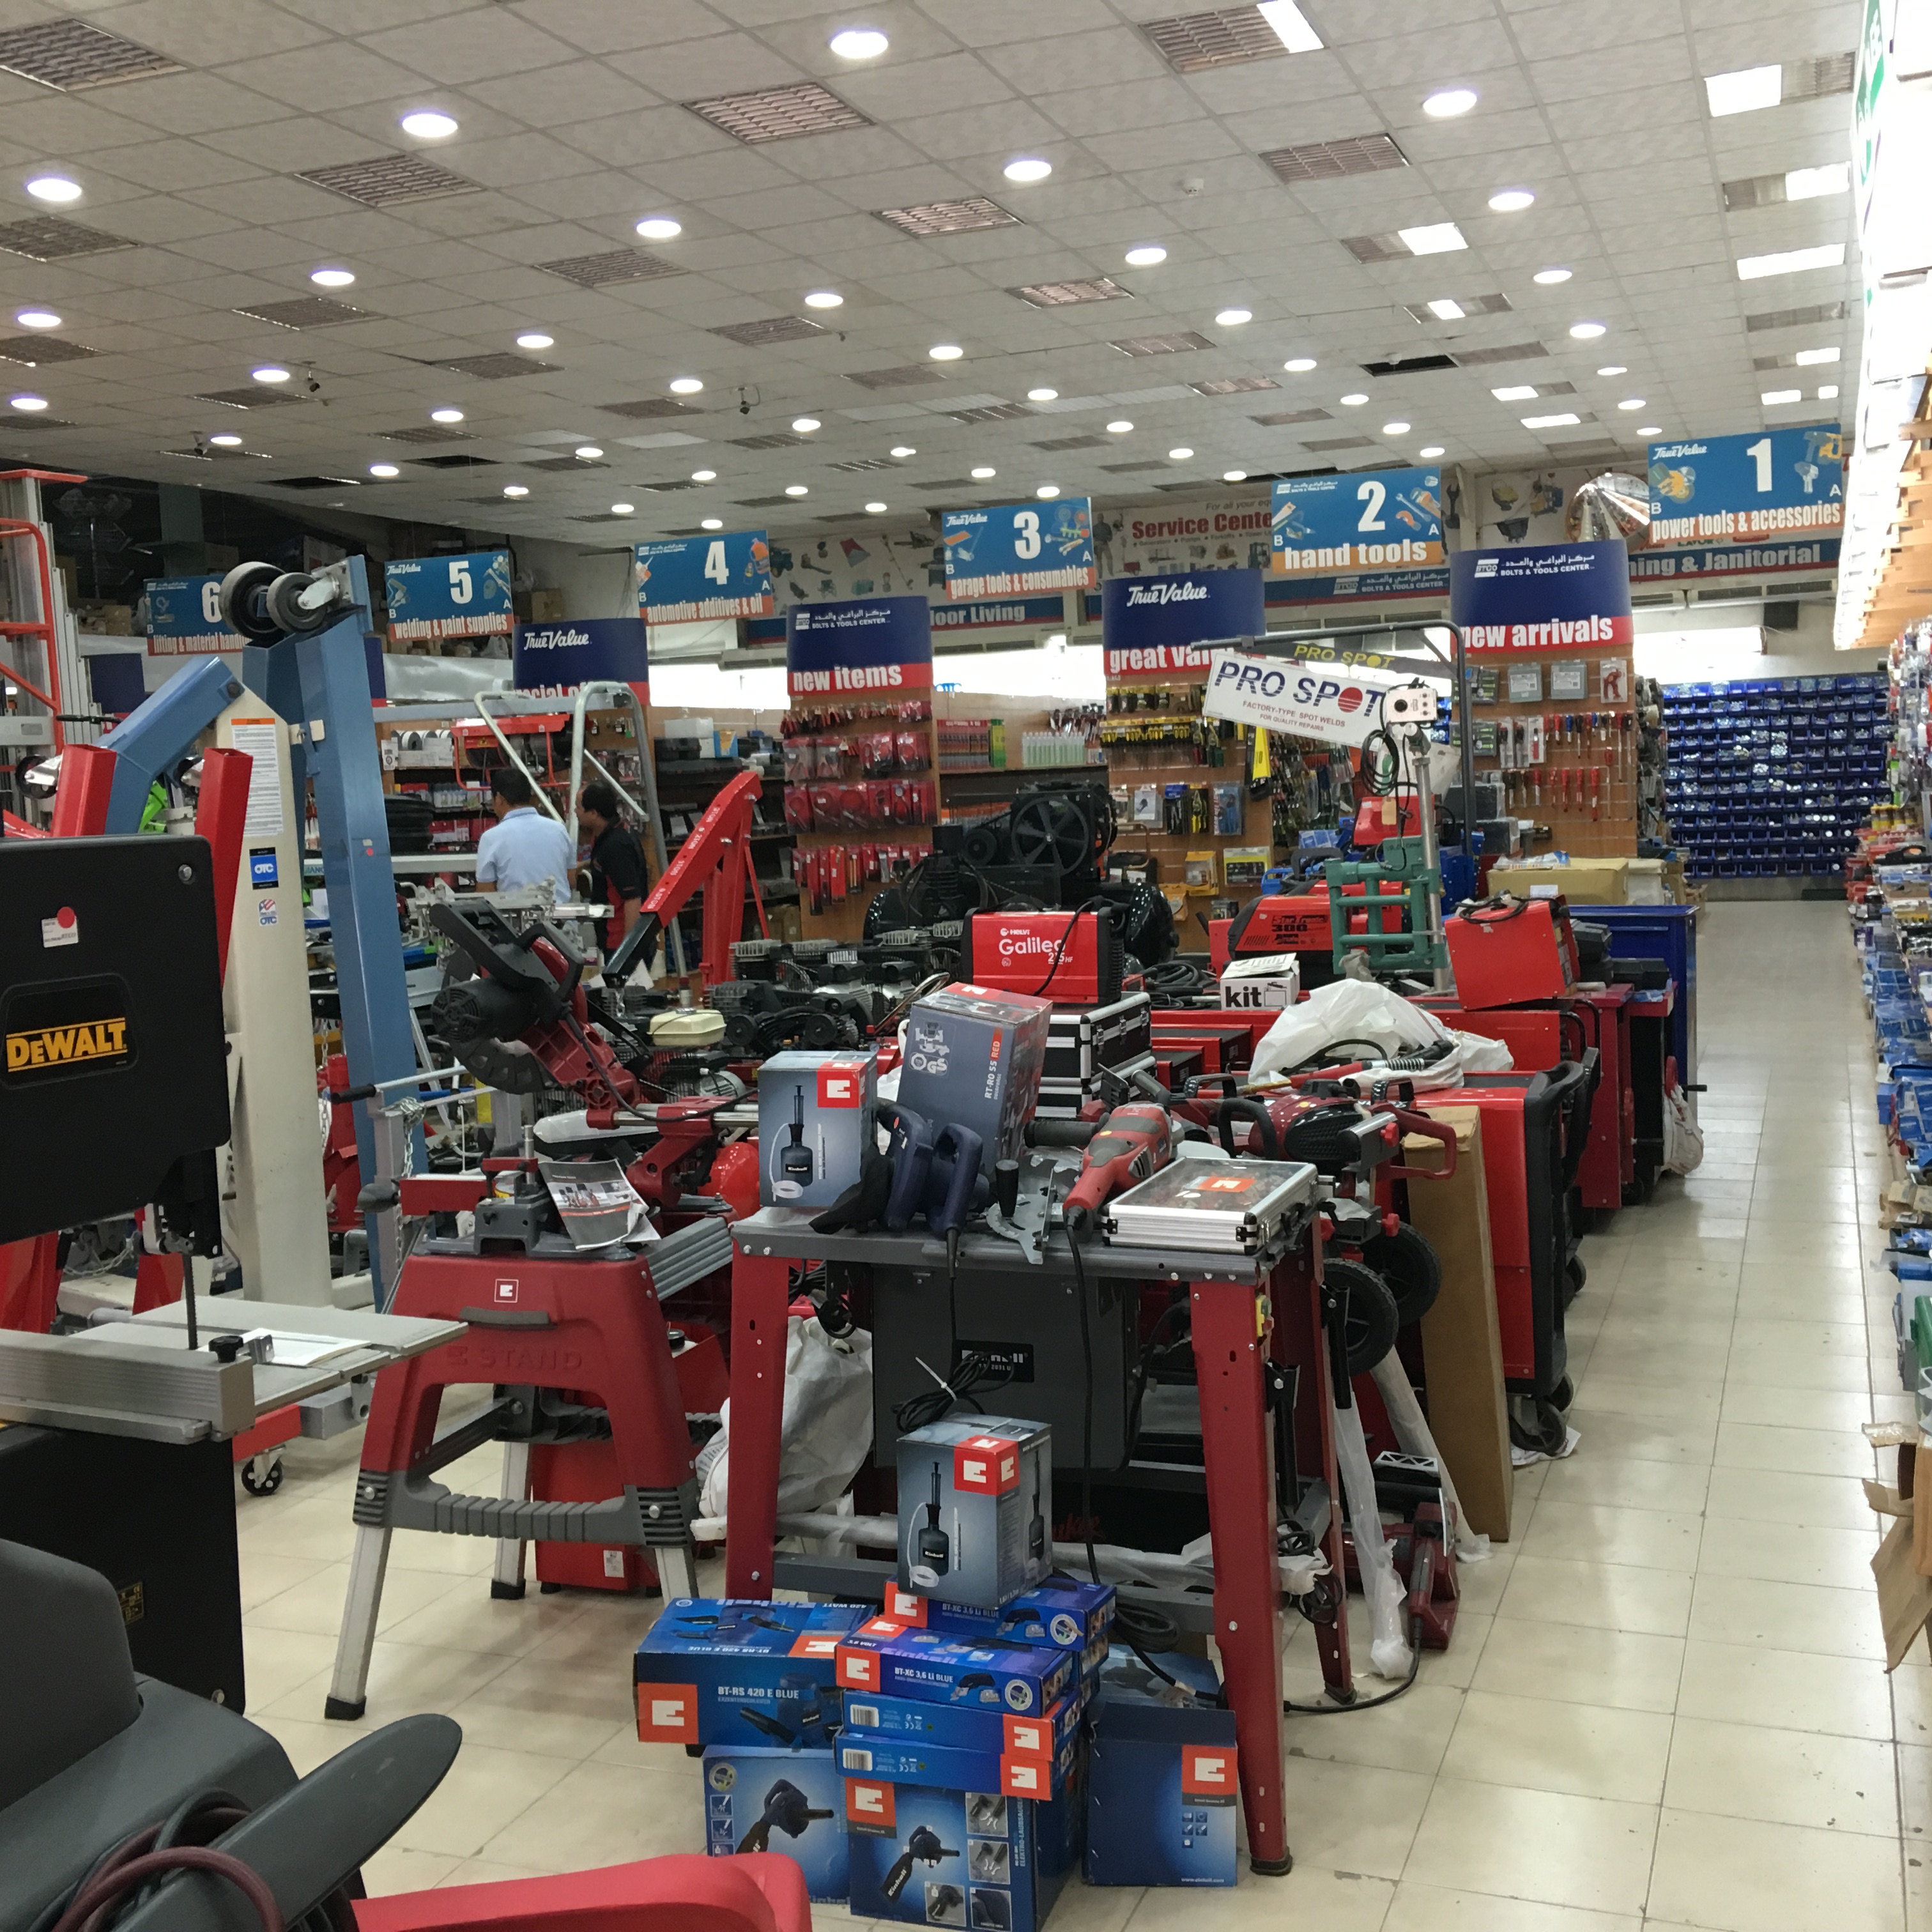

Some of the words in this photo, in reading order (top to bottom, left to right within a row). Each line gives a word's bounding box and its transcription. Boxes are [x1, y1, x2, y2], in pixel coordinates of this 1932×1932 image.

[1747, 438, 1772, 493] 1
[1829, 484, 1842, 497] A
[1206, 502, 1221, 511] For
[1223, 502, 1234, 510] all
[1236, 501, 1255, 513] your
[1357, 480, 1386, 532] 2
[1651, 502, 1662, 514] B
[1132, 518, 1209, 539] Service
[1429, 523, 1439, 536] A
[1652, 516, 1696, 542] power
[1699, 510, 1735, 537] tools
[1738, 512, 1748, 532] &
[1751, 500, 1841, 530] accessories
[1013, 511, 1041, 560] 3
[1274, 535, 1284, 546] B
[705, 540, 729, 585] 4
[1082, 551, 1092, 562] A
[1285, 542, 1351, 569] hand
[1357, 539, 1427, 564] tools
[1535, 554, 1566, 567] البراغي
[1568, 555, 1595, 564] مركز
[1681, 556, 1699, 572] &
[1703, 544, 1820, 571] Janitorial
[946, 564, 954, 574] B
[1560, 564, 1590, 572] CENTER
[449, 560, 473, 604] 5
[762, 580, 770, 590] A
[951, 576, 985, 600] garage
[986, 571, 1011, 594] tools
[1013, 573, 1021, 592] &
[1022, 565, 1089, 591] consumables
[201, 581, 222, 623] 6
[503, 599, 511, 609] A
[639, 592, 647, 602] B
[389, 609, 396, 618] B
[647, 600, 697, 624] automotive
[698, 595, 740, 618] additives
[742, 597, 749, 615] &
[750, 593, 763, 613] oil
[970, 605, 1025, 624] Living
[147, 624, 154, 634] B
[394, 618, 432, 640] welding
[433, 619, 440, 636] &
[441, 615, 466, 638] paint
[466, 611, 508, 634] supplies
[859, 617, 886, 625] CENTER
[1460, 624, 1506, 648] new
[1512, 615, 1613, 647] arrivals
[153, 634, 178, 656] lifting
[178, 636, 185, 652] &
[185, 632, 219, 652] material
[1110, 645, 1168, 673] great
[1294, 644, 1335, 662] PRO
[1340, 650, 1395, 669] SPOT
[793, 670, 830, 692] new
[834, 664, 903, 690] items
[1215, 661, 1285, 697] PRO
[1293, 677, 1384, 717] SPOT
[1243, 700, 1296, 717] FACTORY-TYPE
[1299, 712, 1318, 722] SPOT
[1319, 716, 1346, 728] WELDS
[1273, 716, 1298, 727] QUALITY
[1298, 721, 1324, 732] REPAIRS
[254, 863, 274, 874] OTC
[260, 916, 277, 926] OTC
[999, 937, 1066, 955] Galileo
[1048, 952, 1065, 963] 25
[1225, 986, 1262, 1008] kit
[7, 1022, 126, 1067] DEWALT
[991, 1041, 1000, 1058] RED
[927, 1058, 947, 1074] GS
[989, 1060, 997, 1072] 55
[985, 1073, 995, 1099] RT-RO
[942, 1603, 962, 1613] BT-XC
[983, 1609, 1000, 1618] BLUE
[894, 1666, 915, 1677] BT-XC
[916, 1670, 927, 1680] 3,6
[928, 1672, 935, 1680] Li
[935, 1673, 954, 1683] BLUE
[717, 1686, 746, 1696] BT-RS
[747, 1688, 765, 1698] 420
[767, 1689, 773, 1698] E
[775, 1689, 799, 1699] BLUE
